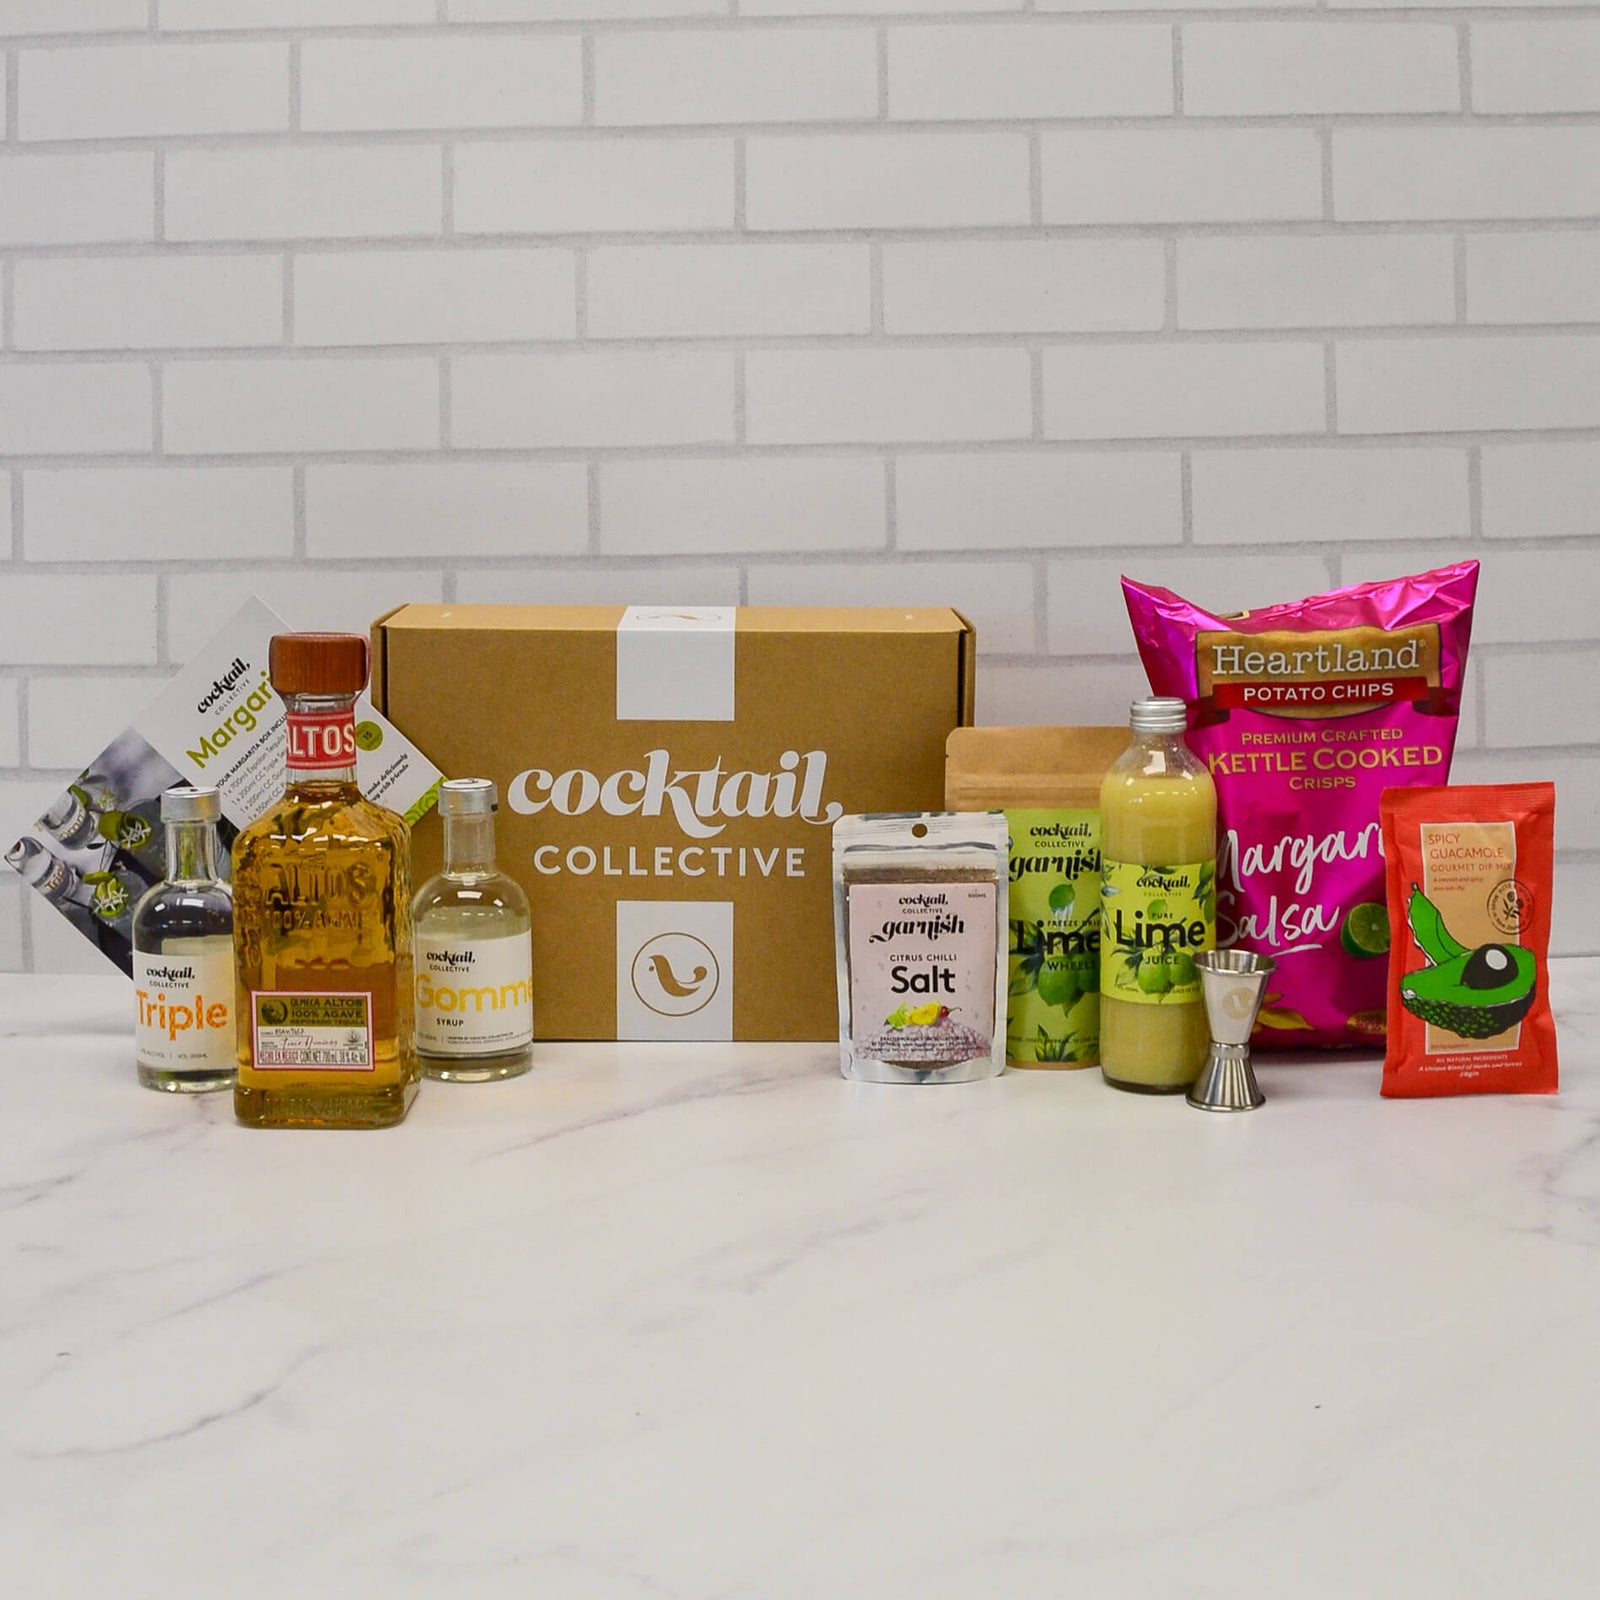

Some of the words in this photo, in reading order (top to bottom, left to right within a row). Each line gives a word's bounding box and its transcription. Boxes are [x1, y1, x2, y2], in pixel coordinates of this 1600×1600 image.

[1243, 686, 1326, 702] POTATO
[1332, 683, 1394, 699] CHIPS
[1241, 731, 1316, 745] PREMIUM
[1321, 728, 1403, 743] CRAFTED
[1207, 751, 1307, 775] KETTLE
[1312, 746, 1443, 770] COOKED
[1289, 777, 1356, 791] CRISPS
[1428, 833, 1461, 845] SPICY
[1430, 848, 1504, 859] GUACAMOLE
[533, 845, 805, 877] COLLECTIVE
[1431, 863, 1475, 872] GOURMET
[1479, 863, 1493, 871] DIP
[1496, 863, 1512, 871] MIX
[868, 914, 964, 943] garnish
[1116, 909, 1206, 948] Lime
[889, 954, 923, 962] CITRUS
[926, 954, 957, 962] CHILLI
[1145, 955, 1180, 965] JUICE
[429, 964, 469, 973] COLLECTIVE
[149, 980, 189, 989] COLLECTIVE
[891, 965, 956, 994] Salt
[136, 989, 228, 1041] Triple
[323, 1009, 363, 1018] AGAVE
[436, 1018, 464, 1027] SYRUP
